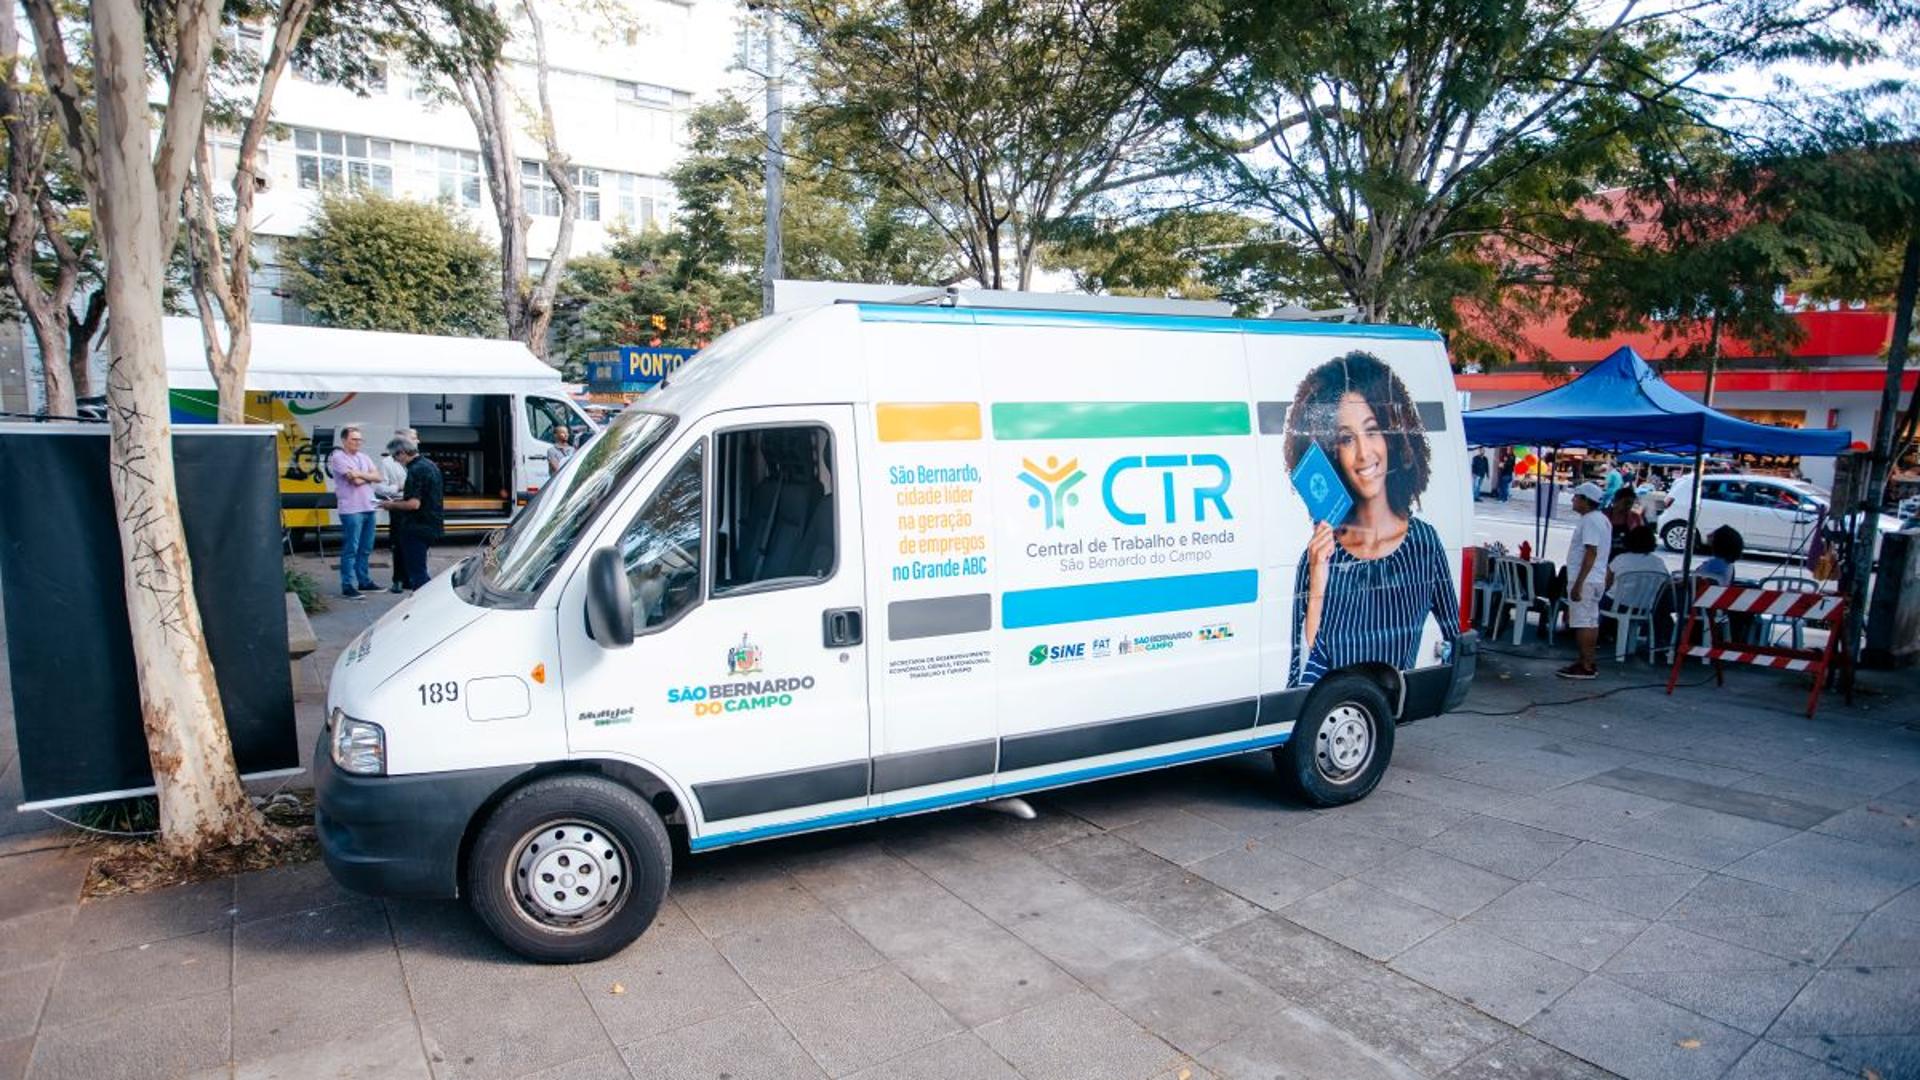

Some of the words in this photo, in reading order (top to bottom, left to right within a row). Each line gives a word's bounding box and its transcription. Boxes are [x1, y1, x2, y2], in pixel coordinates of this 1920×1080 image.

[630, 352, 683, 377] PONTO
[889, 464, 915, 485] São
[917, 463, 982, 485] Bernardo,
[896, 486, 942, 506] cidade
[944, 484, 974, 504] líder
[1101, 453, 1234, 526] CTR
[898, 515, 915, 530] na
[918, 508, 972, 534] geração
[899, 536, 916, 555] de
[919, 535, 985, 556] empregos
[1026, 539, 1083, 558] Central
[1088, 537, 1108, 554] de
[1112, 532, 1175, 552] Trabalho
[1179, 534, 1189, 547] e
[1192, 529, 1235, 546] Renda
[892, 566, 910, 581] no
[912, 558, 960, 579] Grande
[962, 556, 987, 576] ABC
[1060, 556, 1085, 572] São
[1089, 552, 1147, 570] Bernardo
[1150, 550, 1167, 565] do
[1169, 547, 1213, 566] Campo
[1092, 638, 1111, 650] FAT
[1145, 641, 1174, 651] CAMPO
[1150, 631, 1192, 644] BERNARDO
[418, 681, 459, 706] 189
[667, 684, 707, 703] SÃO
[709, 676, 815, 699] BERNARDO
[694, 701, 722, 717] DO
[724, 694, 793, 712] CAMPO
